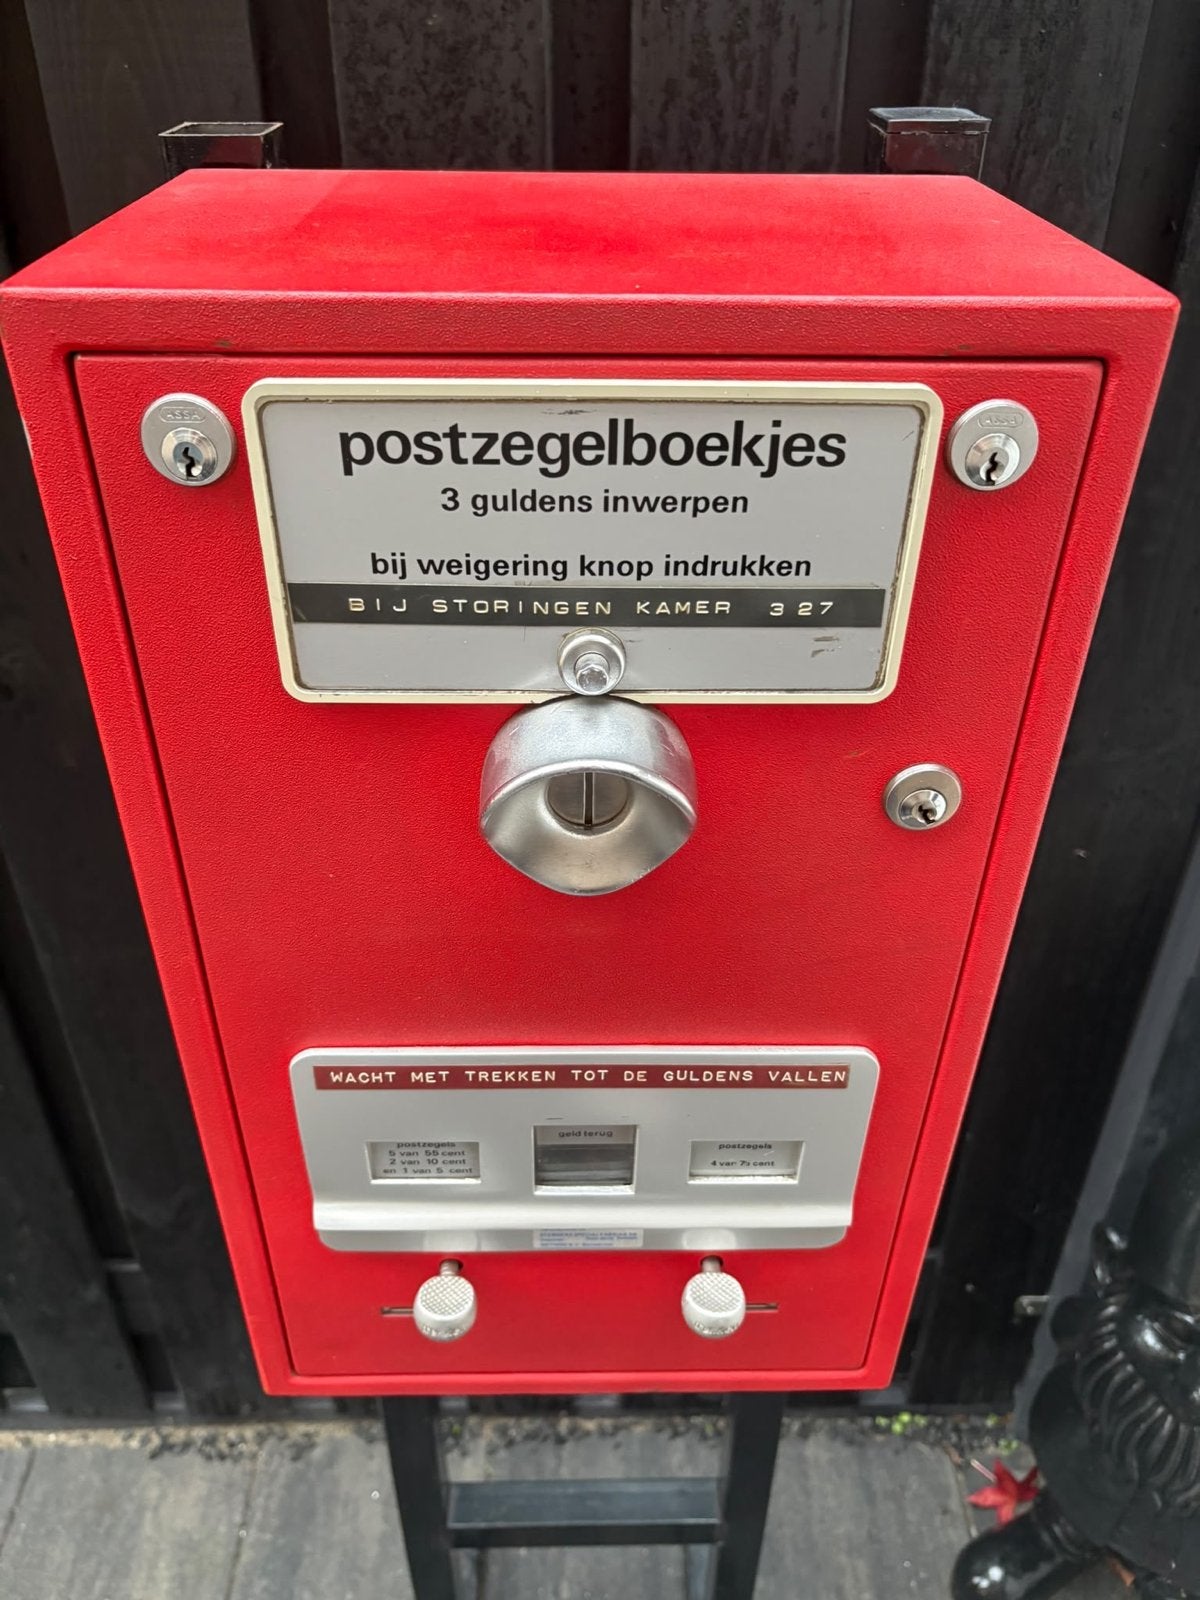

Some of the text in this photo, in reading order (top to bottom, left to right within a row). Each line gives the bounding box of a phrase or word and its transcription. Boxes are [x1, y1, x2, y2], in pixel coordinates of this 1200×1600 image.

[339, 418, 847, 478] postzegelboekjes
[440, 487, 749, 518] 3 guldens inwerpen
[371, 552, 812, 581] bij weigering knop indrukken
[348, 597, 407, 612] BIJ
[432, 599, 612, 615] STORINGEN
[636, 601, 731, 615] KAMER
[330, 1069, 847, 1084] WACHT MET TREKKEN TOT DE GULDENS VALLEN
[558, 1130, 613, 1138] geld terug
[397, 1141, 456, 1149] postzegels
[389, 1158, 397, 1166] 2
[426, 1158, 439, 1166] 10
